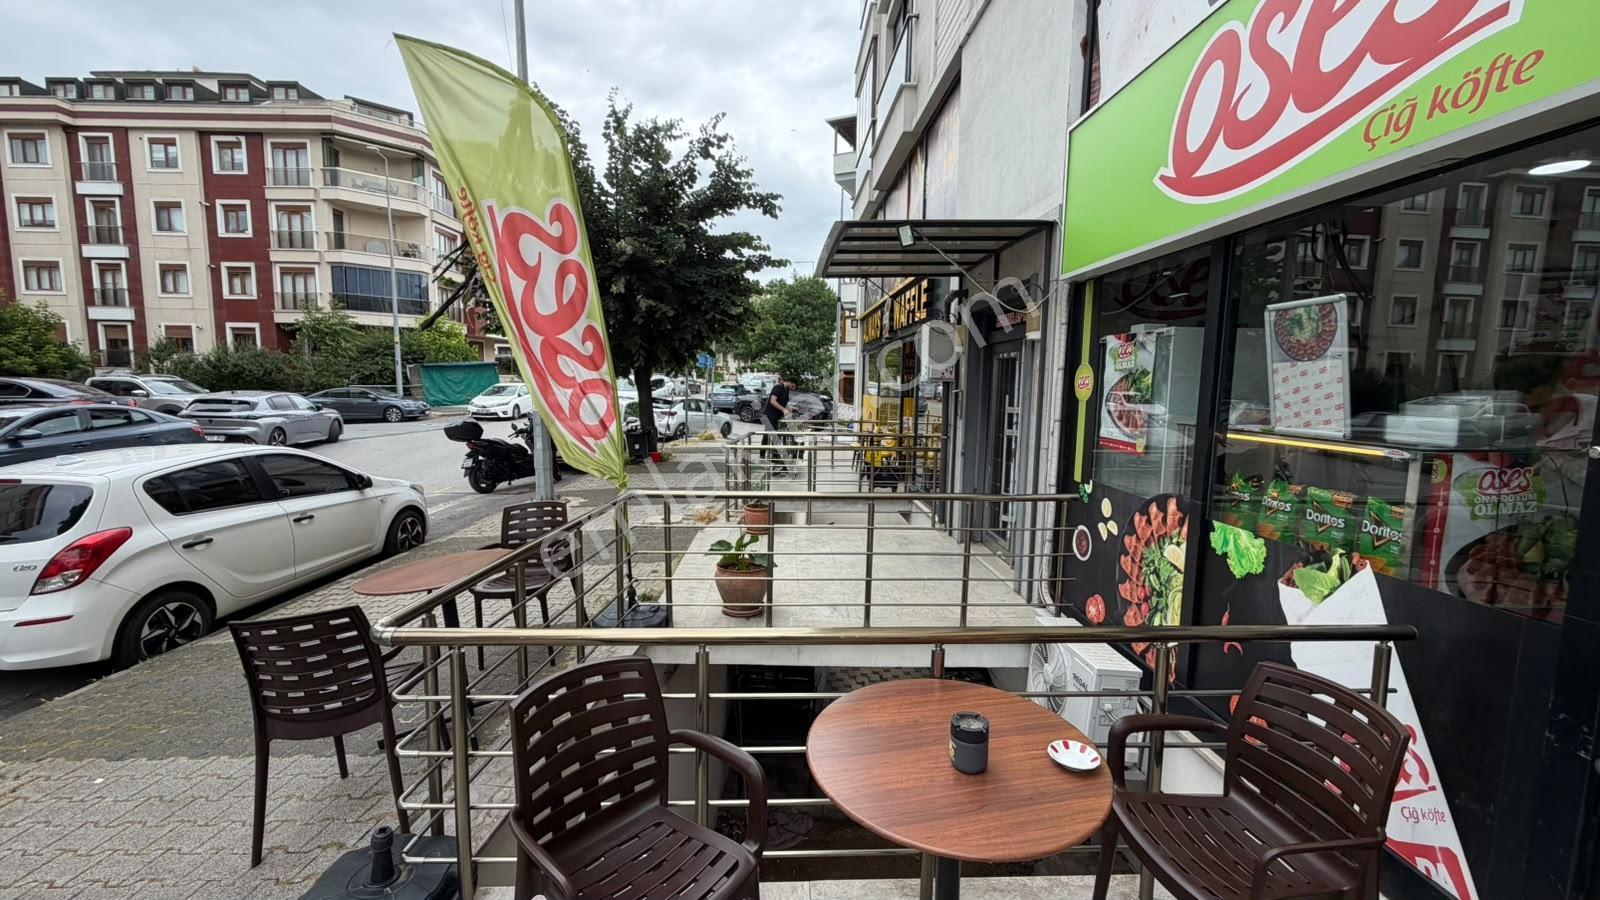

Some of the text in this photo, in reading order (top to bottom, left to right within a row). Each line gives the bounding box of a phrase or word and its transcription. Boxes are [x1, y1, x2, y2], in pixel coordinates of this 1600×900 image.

[1362, 48, 1545, 151] Çiğ köfte
[893, 279, 928, 331] WAFFLE
[1306, 508, 1346, 529] Doritos
[1474, 501, 1537, 516] OLMAZ
[1401, 806, 1446, 826] Çiğ köfte
